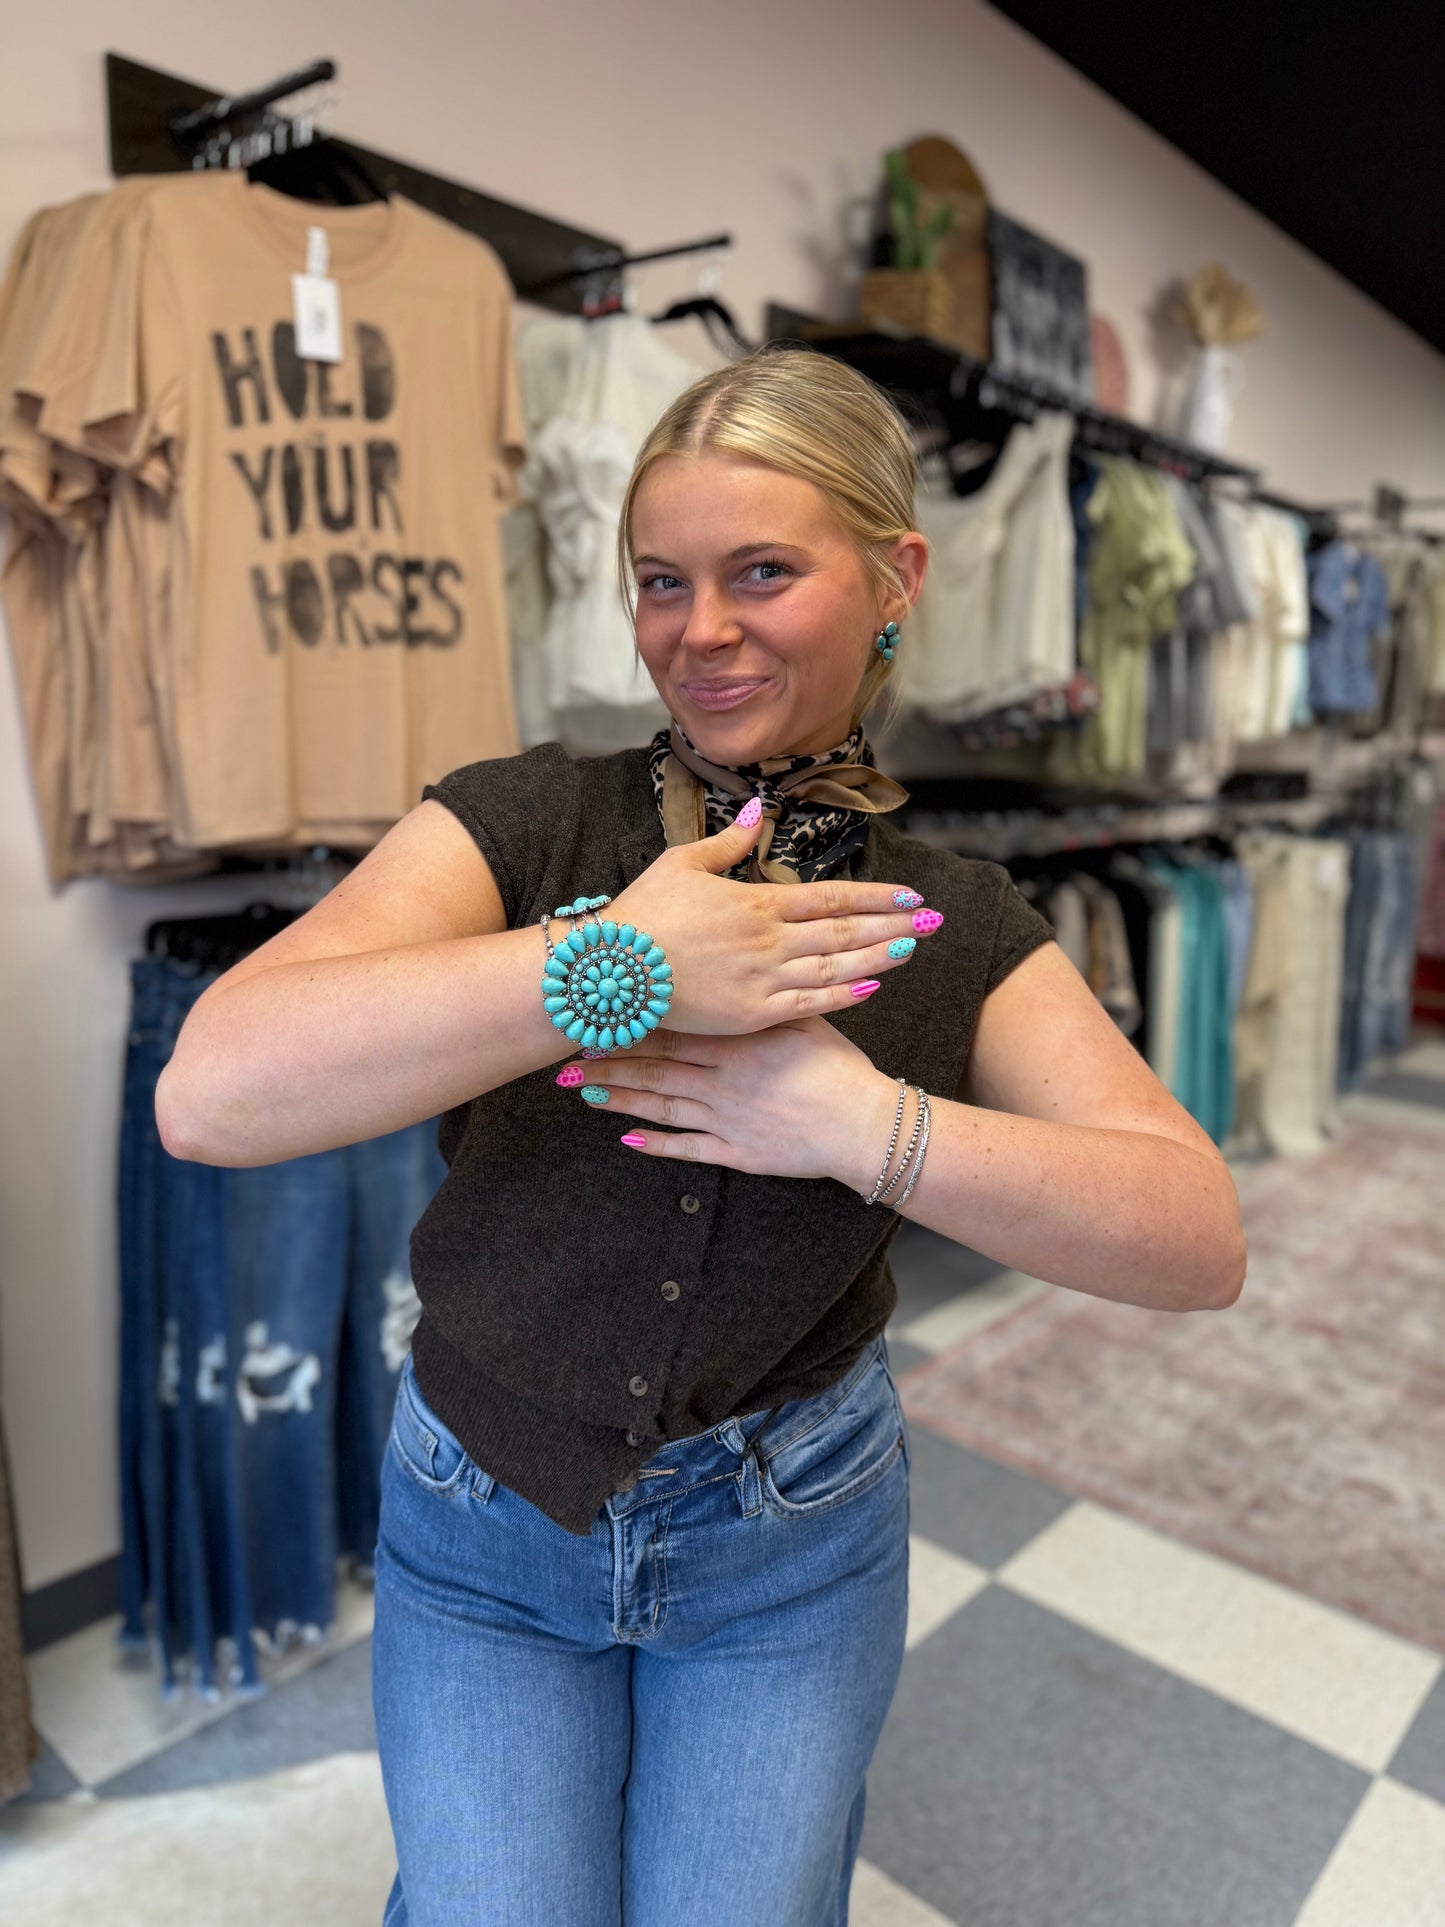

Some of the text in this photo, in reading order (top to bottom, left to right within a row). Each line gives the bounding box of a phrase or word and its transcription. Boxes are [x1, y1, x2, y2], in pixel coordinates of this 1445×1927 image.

[211, 319, 396, 427] HOLD
[230, 438, 404, 542] YOUR
[250, 552, 464, 655] HORSES
